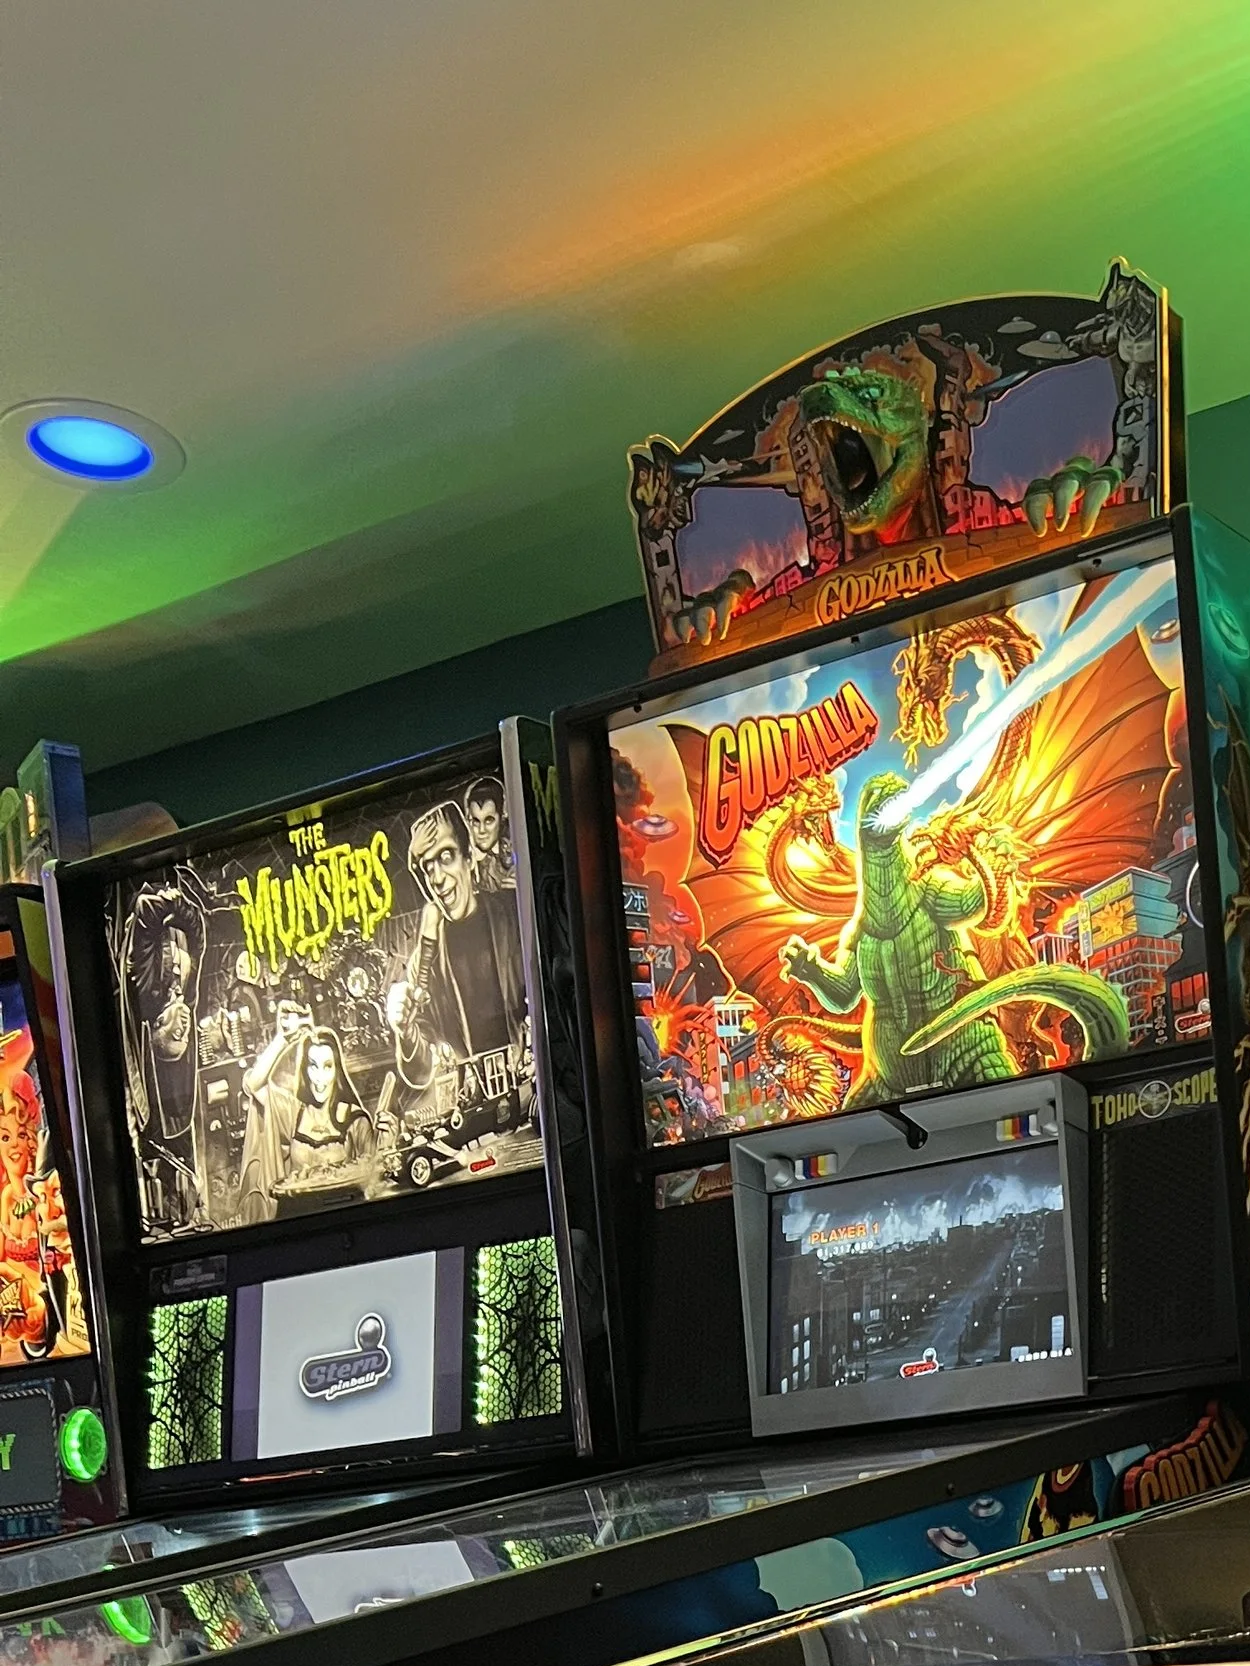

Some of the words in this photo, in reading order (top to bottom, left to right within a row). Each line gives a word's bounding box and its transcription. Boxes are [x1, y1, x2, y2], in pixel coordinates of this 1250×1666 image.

[818, 548, 952, 625] GODZILLA
[702, 682, 878, 855] GODZILLA
[289, 822, 326, 857] THE
[236, 831, 393, 978] MUNSTERS
[1089, 1093, 1137, 1130] TOHO
[1171, 1067, 1217, 1105] SCOPE
[810, 1223, 867, 1245] PLAYER
[872, 1222, 879, 1235] 1
[309, 1355, 381, 1387] Stern
[329, 1372, 375, 1394] pinball
